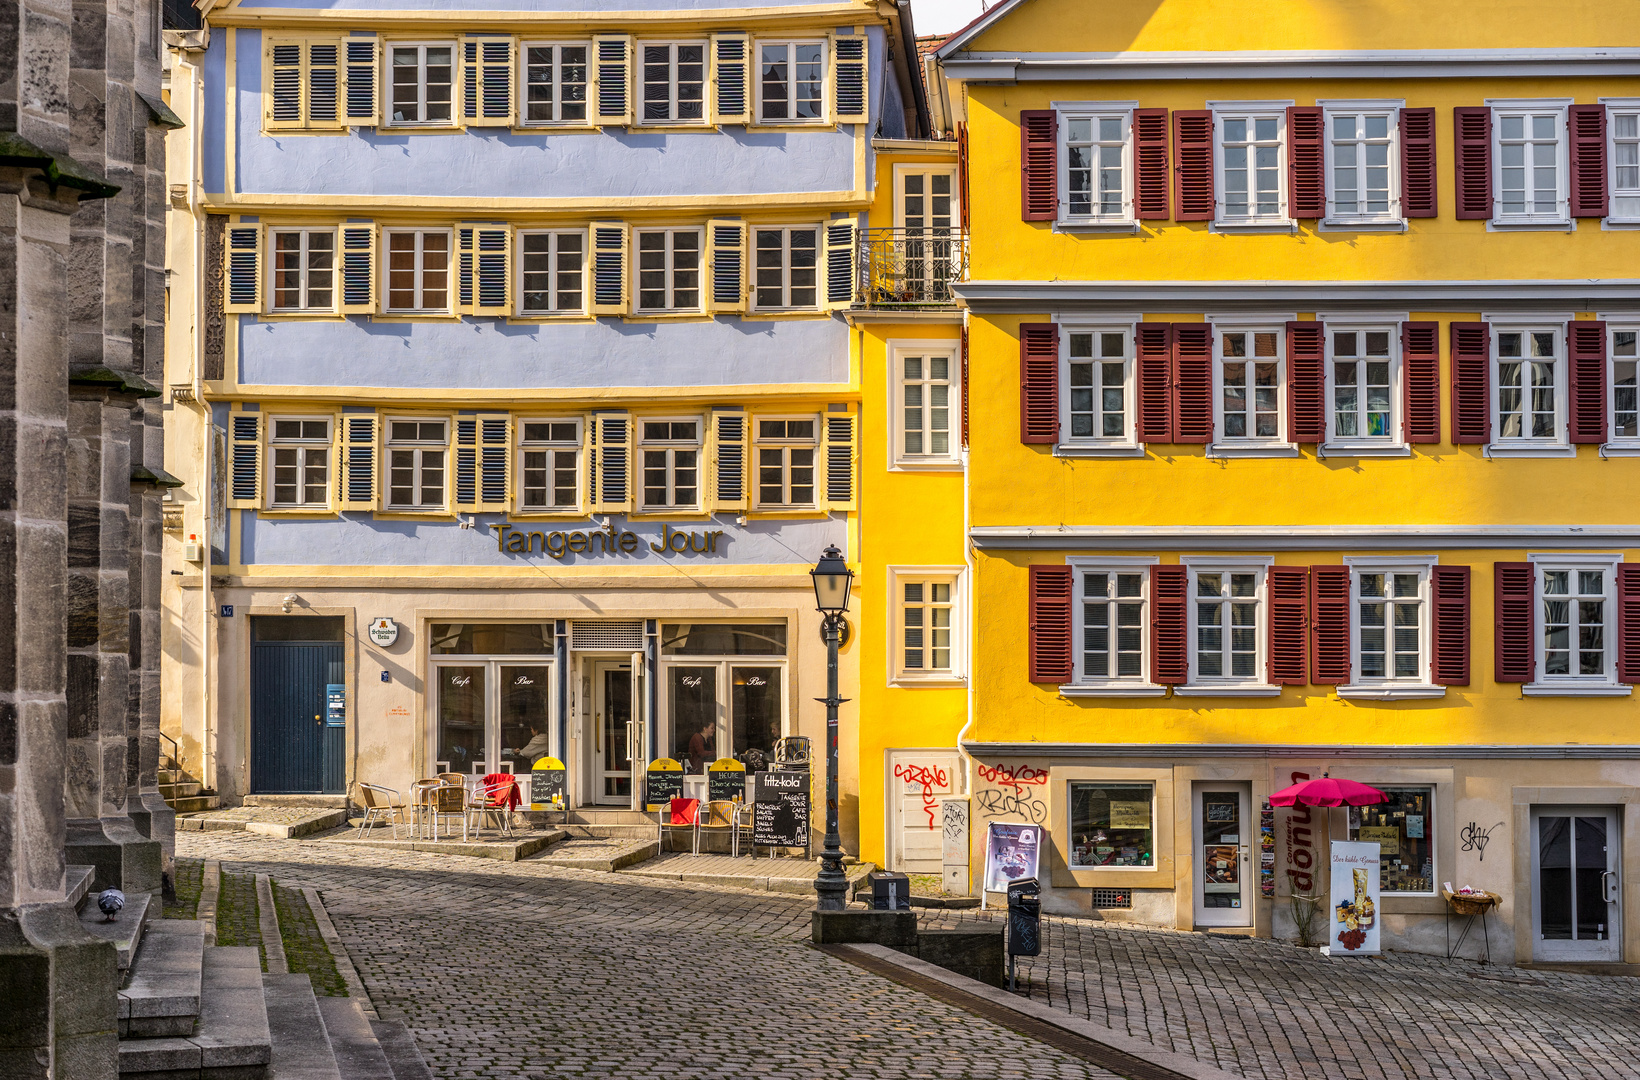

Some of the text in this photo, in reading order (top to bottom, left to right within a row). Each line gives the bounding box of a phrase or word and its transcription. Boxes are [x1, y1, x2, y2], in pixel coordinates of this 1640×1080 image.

[489, 523, 724, 559] Tangente Jour
[515, 676, 534, 686] Bar
[747, 676, 766, 686] Bar
[764, 775, 801, 788] fritz-kola
[1333, 854, 1344, 863] Der
[1359, 855, 1379, 866] Genuss
